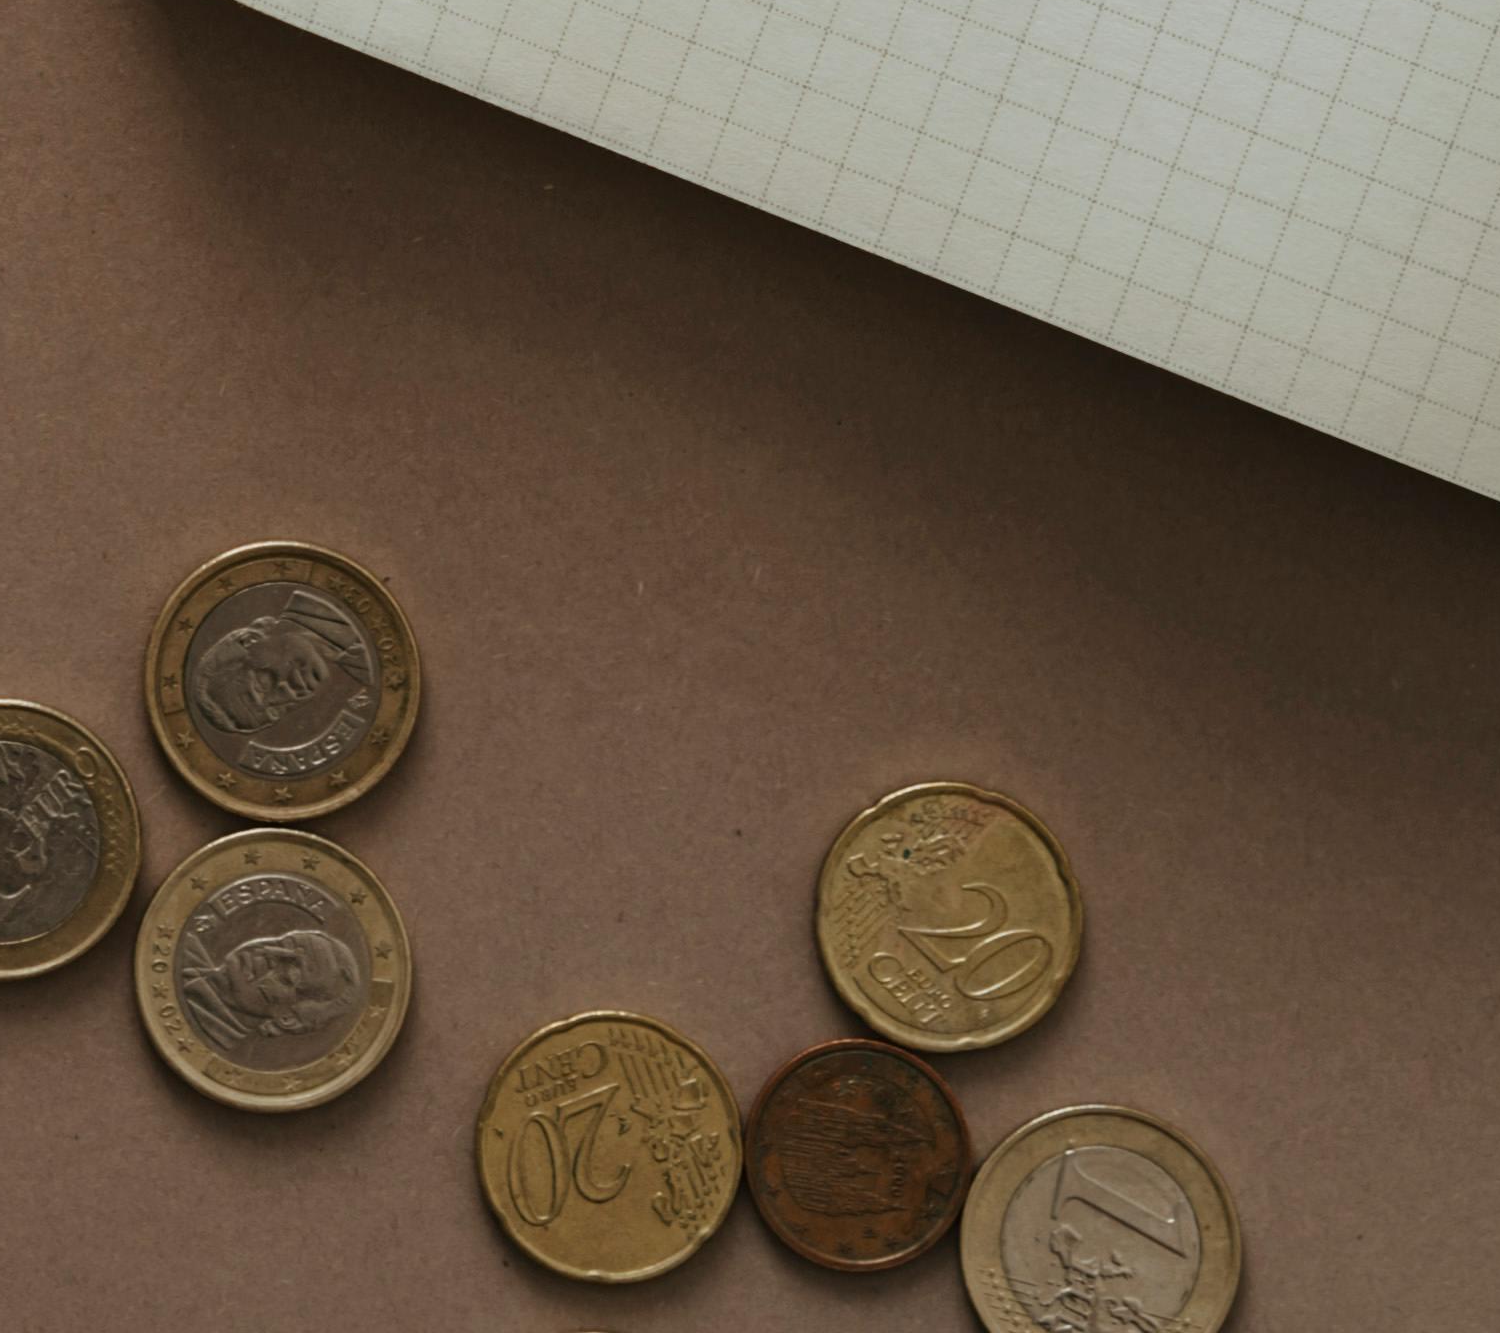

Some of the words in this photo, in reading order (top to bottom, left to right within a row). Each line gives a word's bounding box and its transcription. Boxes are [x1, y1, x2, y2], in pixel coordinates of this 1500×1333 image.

[867, 951, 945, 1027] CENT
[899, 883, 1051, 1000] 20
[514, 1040, 606, 1093] CENT
[509, 1083, 631, 1227] 20
[1053, 1139, 1186, 1259] 1
